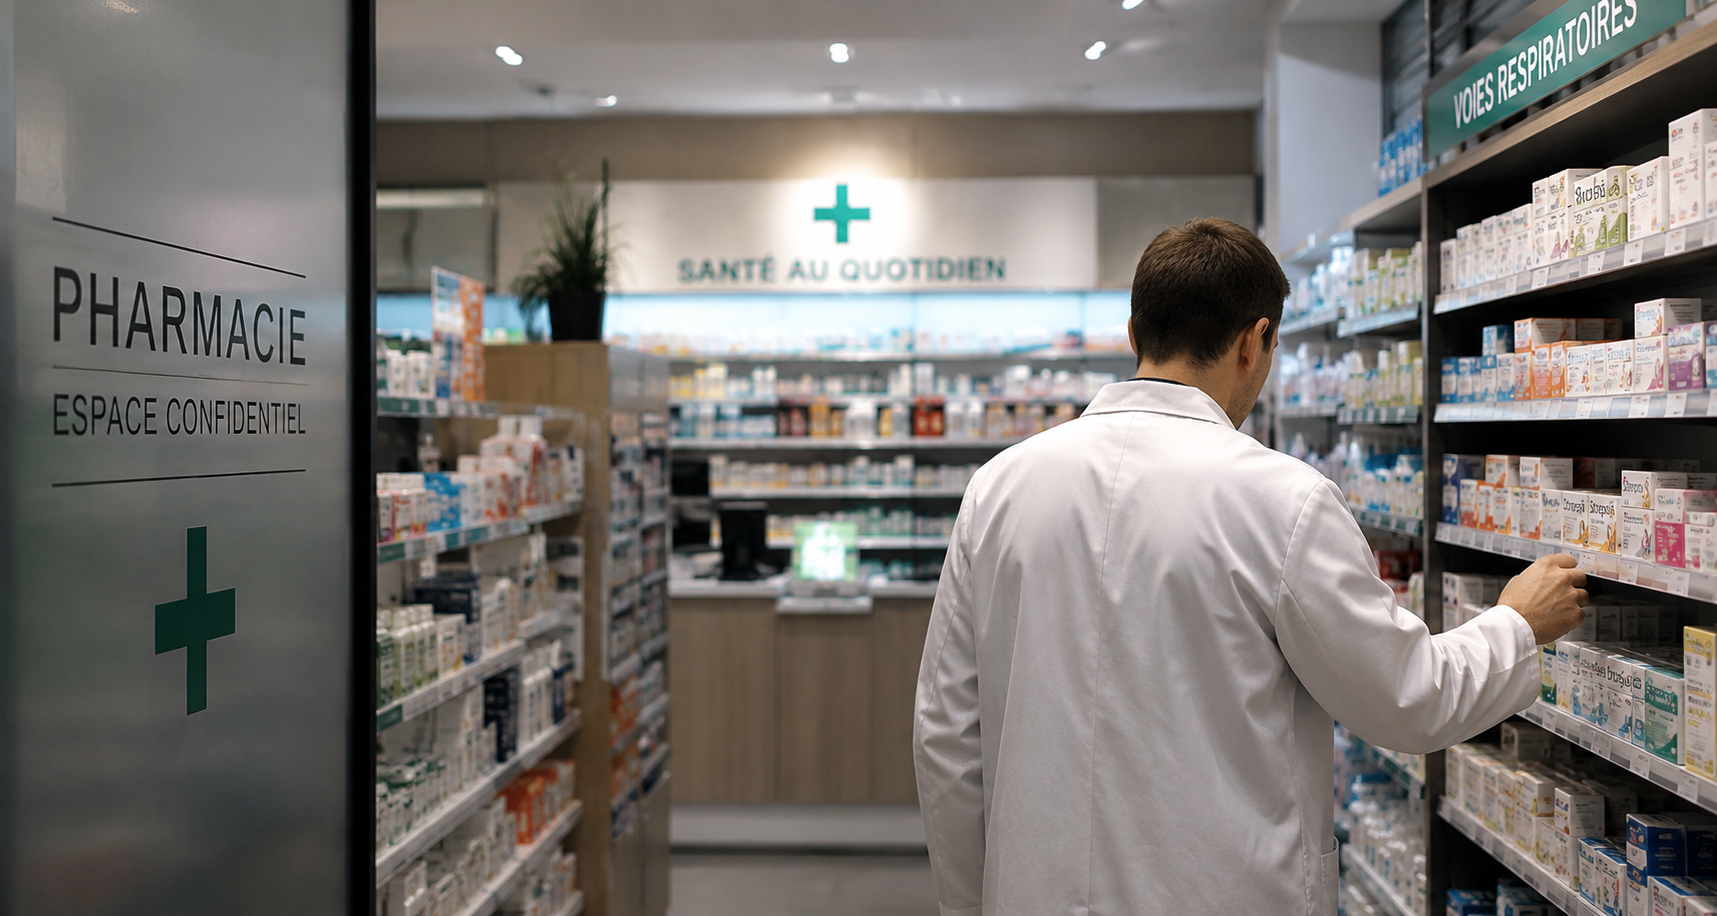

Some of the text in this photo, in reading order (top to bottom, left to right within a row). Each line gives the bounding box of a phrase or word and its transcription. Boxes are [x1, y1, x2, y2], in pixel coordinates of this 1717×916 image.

[1453, 0, 1637, 129] VOIES RESPIRATOIRES
[677, 252, 1006, 283] SANTÉ AU QUOTIDIEN
[53, 266, 306, 366] PHARMACIE
[53, 393, 306, 436] ESPACE CONFIDENTIEL
